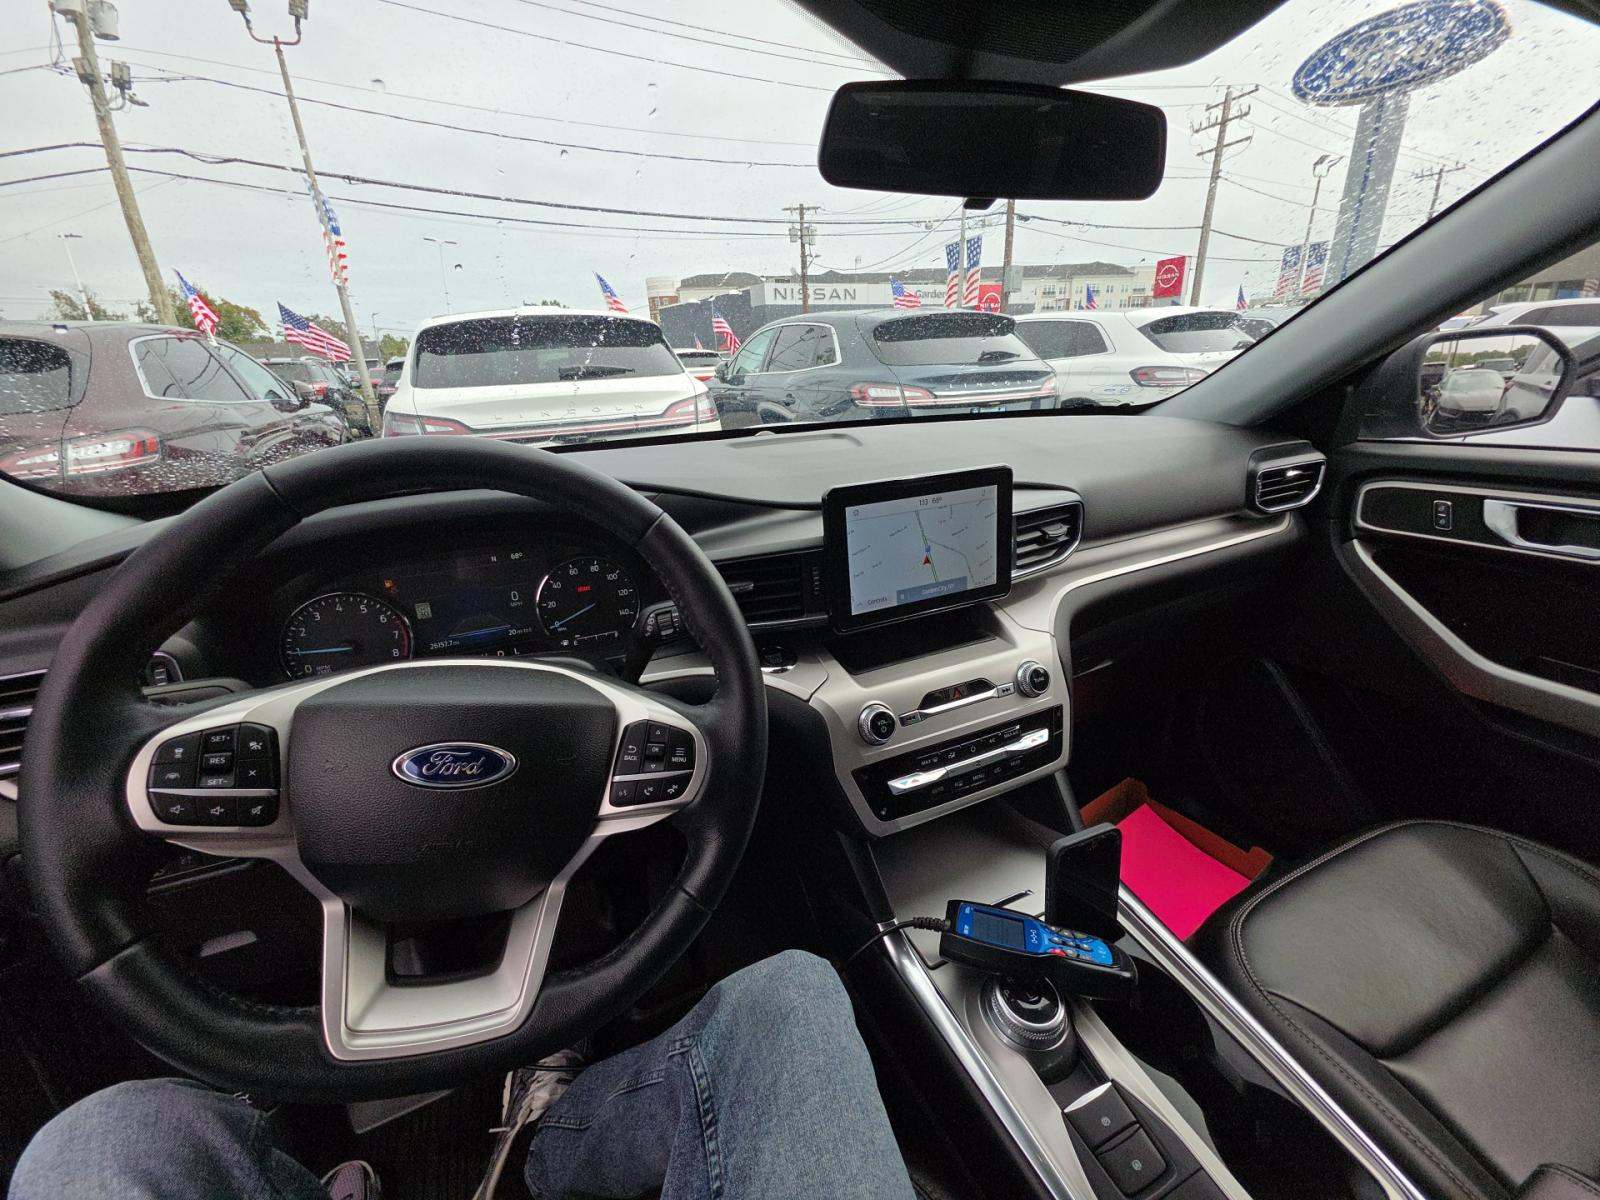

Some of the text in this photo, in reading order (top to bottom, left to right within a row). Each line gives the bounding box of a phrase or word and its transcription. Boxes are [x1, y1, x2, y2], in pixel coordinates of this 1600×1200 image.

[774, 287, 857, 301] NISSAN
[949, 379, 1033, 389] LINCOLN
[569, 567, 579, 576] 60
[590, 564, 599, 572] 80
[606, 573, 618, 581] 100
[552, 581, 562, 589] 40
[511, 591, 519, 601] 0
[618, 588, 629, 596] 120
[335, 603, 343, 612] 4
[360, 604, 368, 614] 5
[547, 601, 557, 609] 20
[314, 611, 321, 621] 3
[619, 608, 630, 616] 140
[379, 614, 387, 623] 6
[299, 627, 306, 637] 2
[393, 630, 400, 639] 7
[392, 648, 400, 657] 8
[304, 664, 312, 673] 0
[211, 735, 231, 743] SET+
[422, 751, 486, 776] Ford
